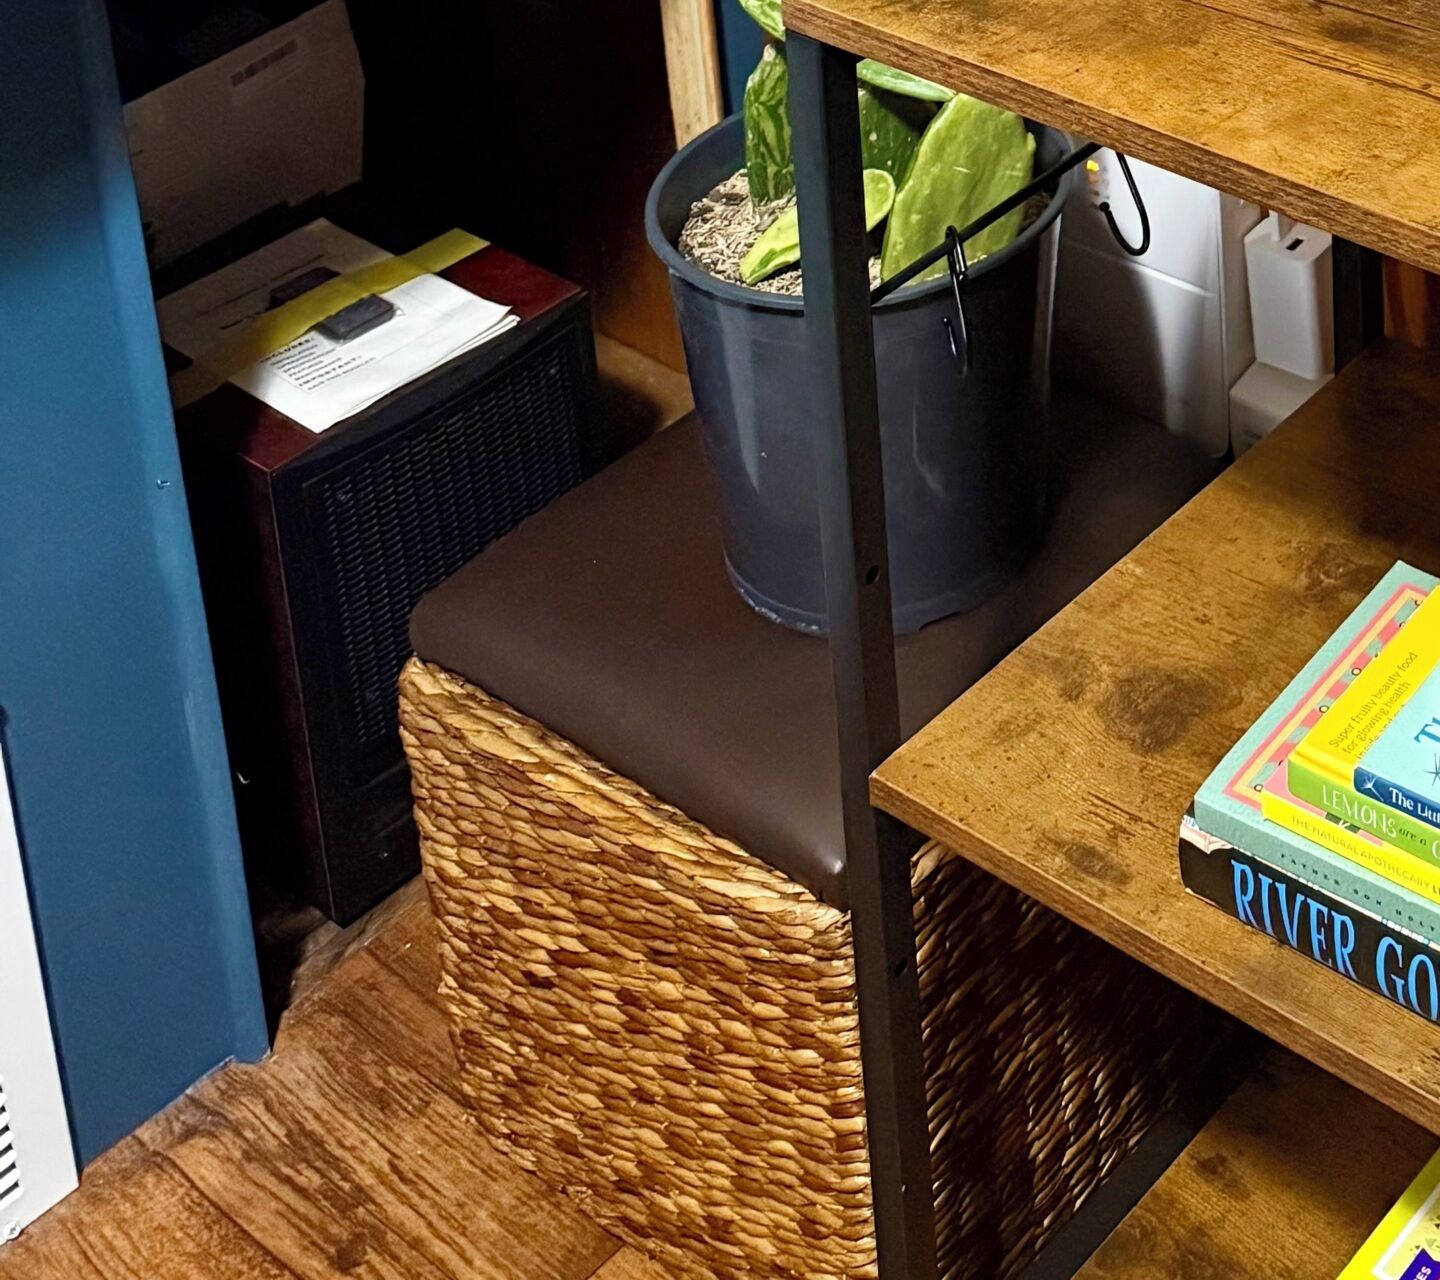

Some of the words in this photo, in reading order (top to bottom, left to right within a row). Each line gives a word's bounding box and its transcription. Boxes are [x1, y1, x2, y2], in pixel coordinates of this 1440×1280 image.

[1329, 725, 1355, 748] Super
[1351, 700, 1378, 724] fruity
[1372, 671, 1401, 699] beauty
[1397, 651, 1418, 672] food
[1343, 741, 1359, 754] for
[1356, 708, 1390, 742] glowing
[1384, 681, 1411, 707] health
[1323, 784, 1397, 838] LEMONS
[1399, 827, 1417, 841] are
[1419, 838, 1427, 846] a
[1389, 787, 1415, 810] The
[1291, 815, 1311, 831] THE
[1313, 823, 1360, 857] NATURAL
[1361, 849, 1430, 889] APOTHECARY
[1231, 859, 1360, 983] RIVER
[1281, 853, 1340, 887] FATHER
[1353, 888, 1383, 906] SON
[1395, 908, 1436, 932] HOLY
